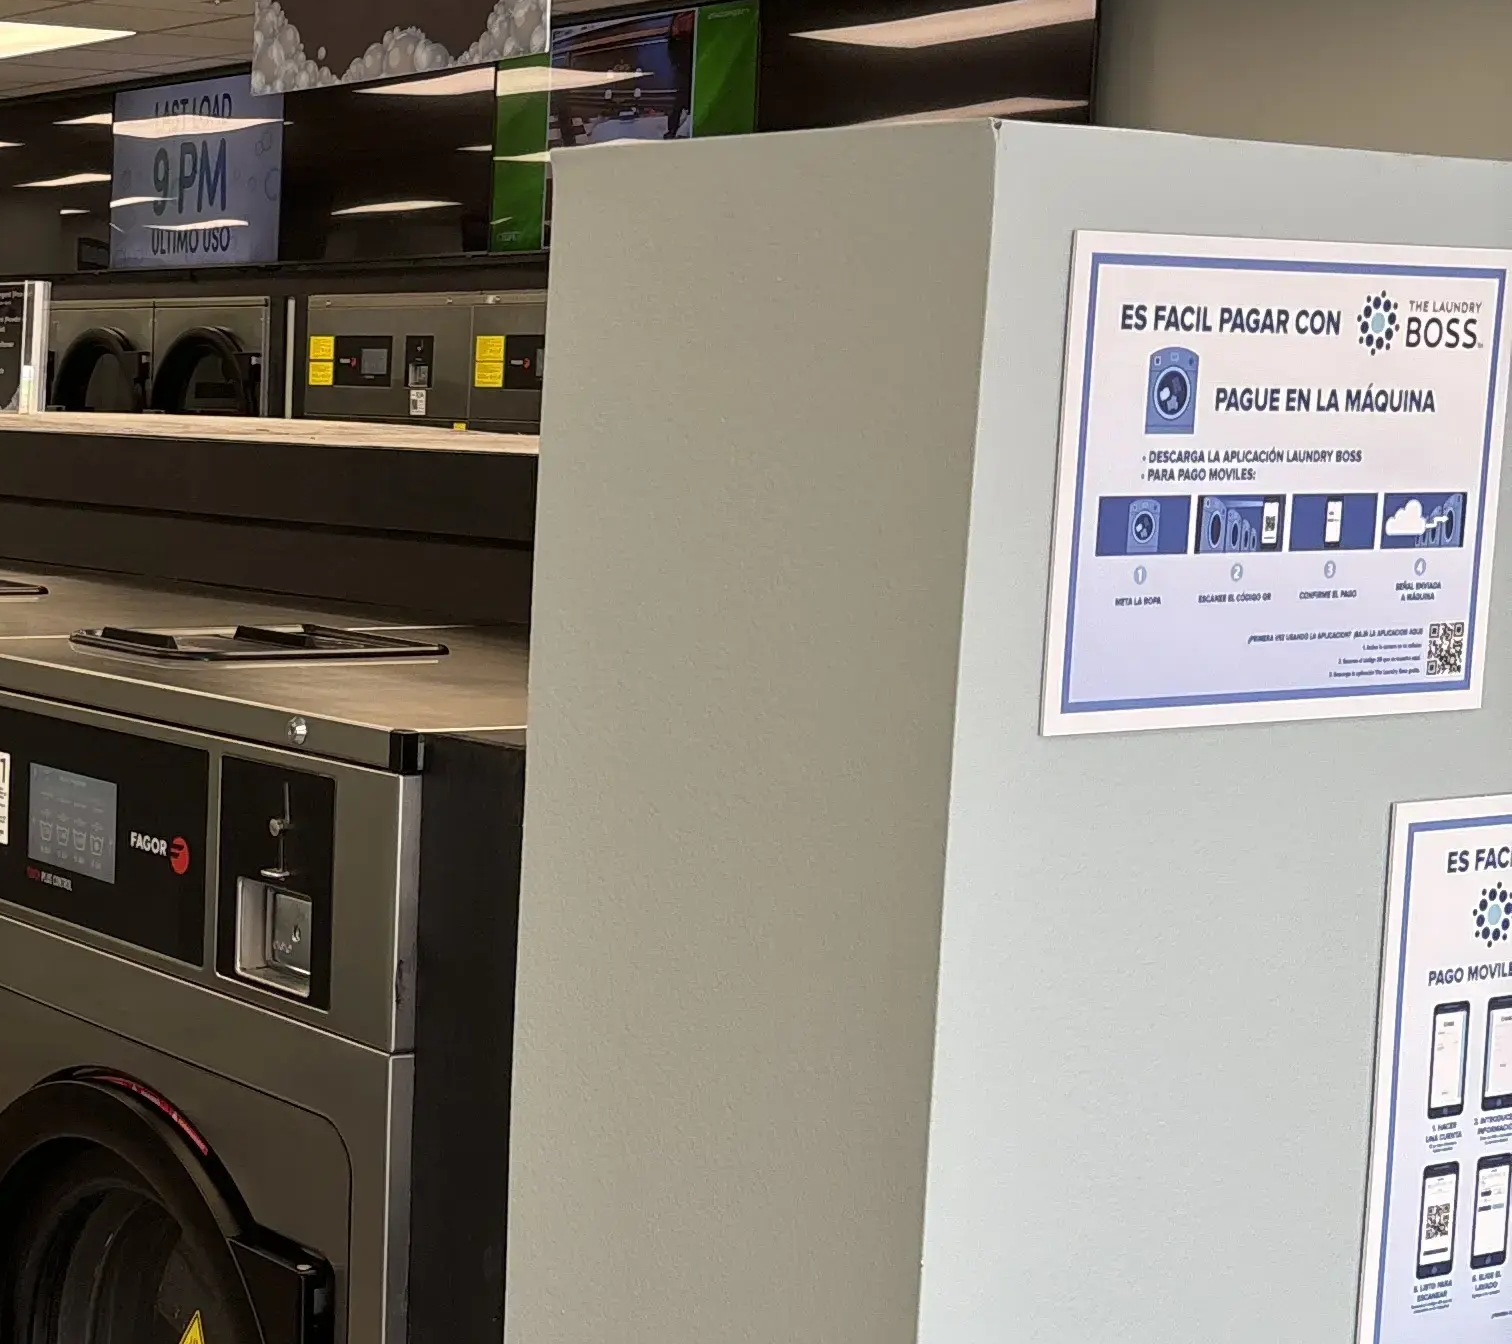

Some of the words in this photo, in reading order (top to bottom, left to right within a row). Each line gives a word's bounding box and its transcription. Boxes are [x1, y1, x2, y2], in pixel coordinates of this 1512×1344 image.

[153, 147, 169, 216] 9
[178, 138, 226, 214] PM
[203, 227, 230, 253] USO
[1409, 300, 1429, 312] THE
[1433, 301, 1482, 313] LAUNDRY
[1121, 303, 1148, 331] ES
[1153, 305, 1212, 333] FACIL
[1218, 307, 1289, 335] PAGAR
[1295, 309, 1341, 336] CON
[1406, 316, 1477, 349] BOSS
[1215, 386, 1280, 412] PAGUE
[1285, 388, 1312, 412] EN
[1316, 388, 1339, 412] LA
[1345, 383, 1435, 413] MÁQUINA
[1149, 450, 1205, 463] DESCARGA
[1208, 450, 1221, 463] LA
[1223, 446, 1284, 463] APLICACIÓN
[1286, 450, 1334, 463] LAUNDRY
[1336, 450, 1362, 463] BOSS
[1147, 468, 1175, 481] PARA
[1178, 468, 1206, 481] PAGO
[1209, 468, 1256, 481] MOVILES:
[0, 758, 6, 783] 1
[130, 831, 168, 856] FAGOR
[1447, 850, 1470, 873] ES
[1428, 967, 1464, 986] PAGO
